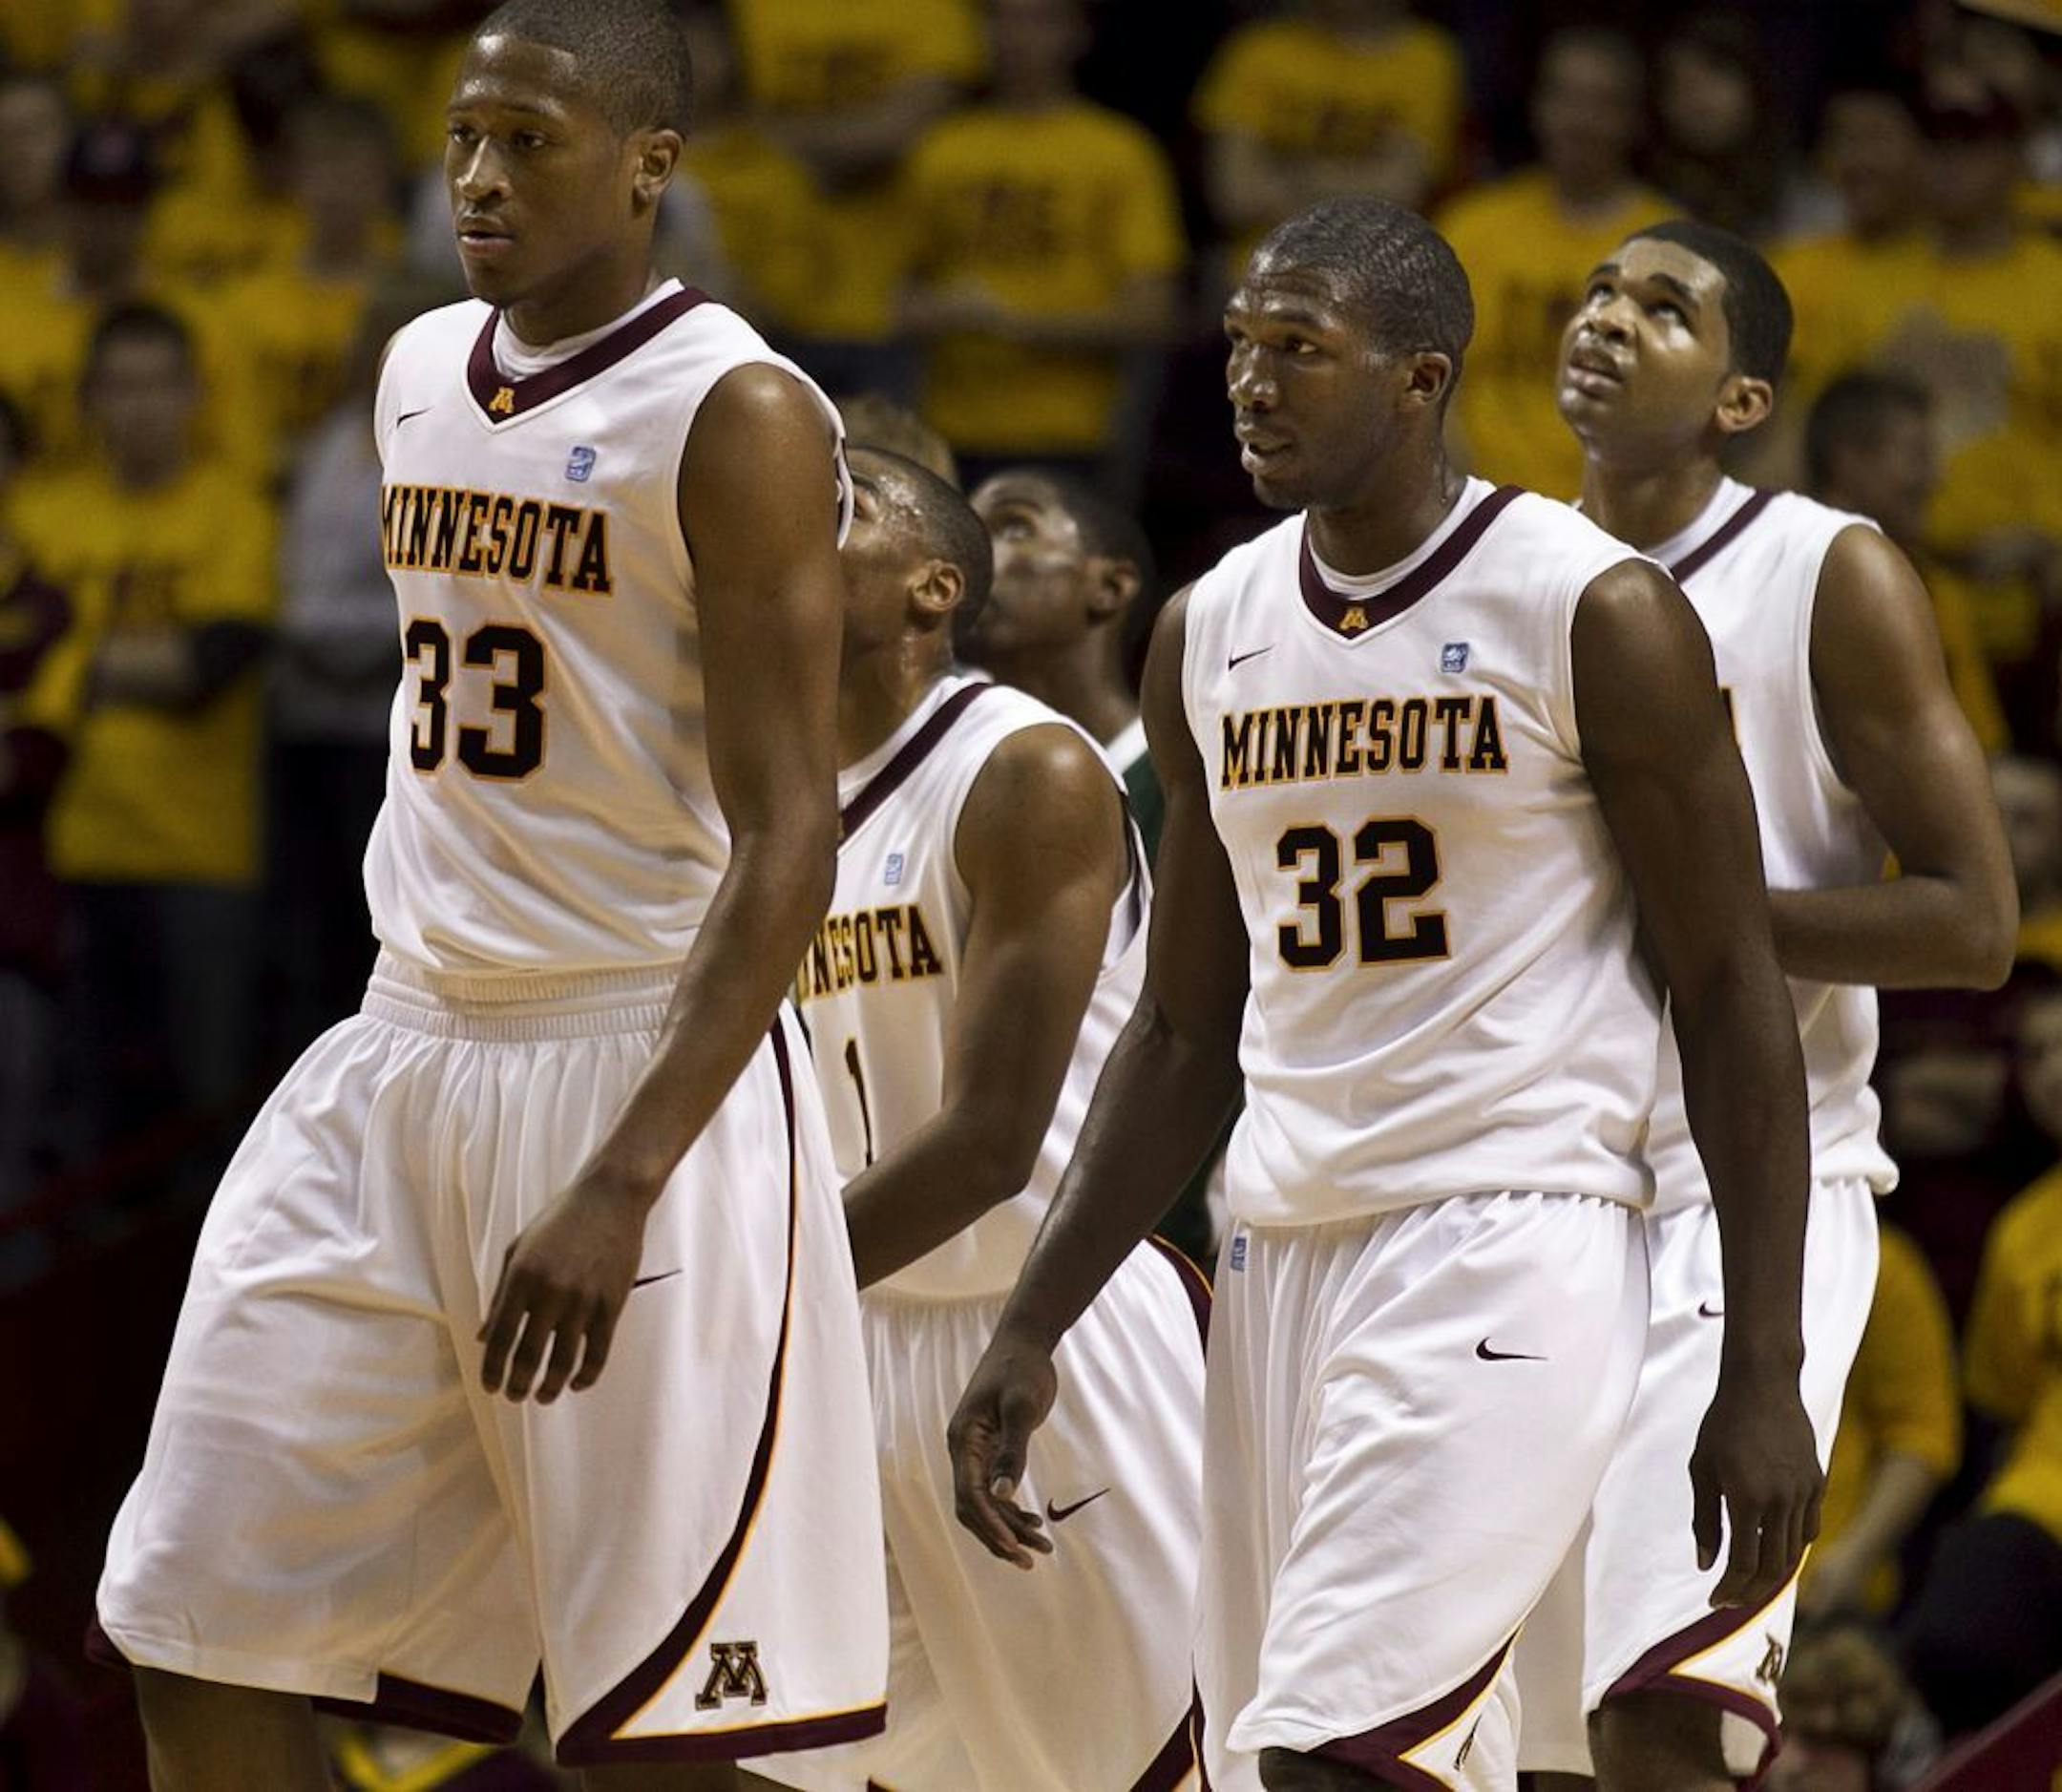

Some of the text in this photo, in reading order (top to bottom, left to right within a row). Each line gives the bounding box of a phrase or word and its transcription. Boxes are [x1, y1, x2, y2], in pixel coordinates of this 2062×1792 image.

[382, 483, 613, 596] MINNESOTA
[403, 615, 549, 783] 33
[1221, 696, 1508, 791] MINNESOTA
[1276, 815, 1452, 973] 32
[695, 1640, 768, 1711] M
